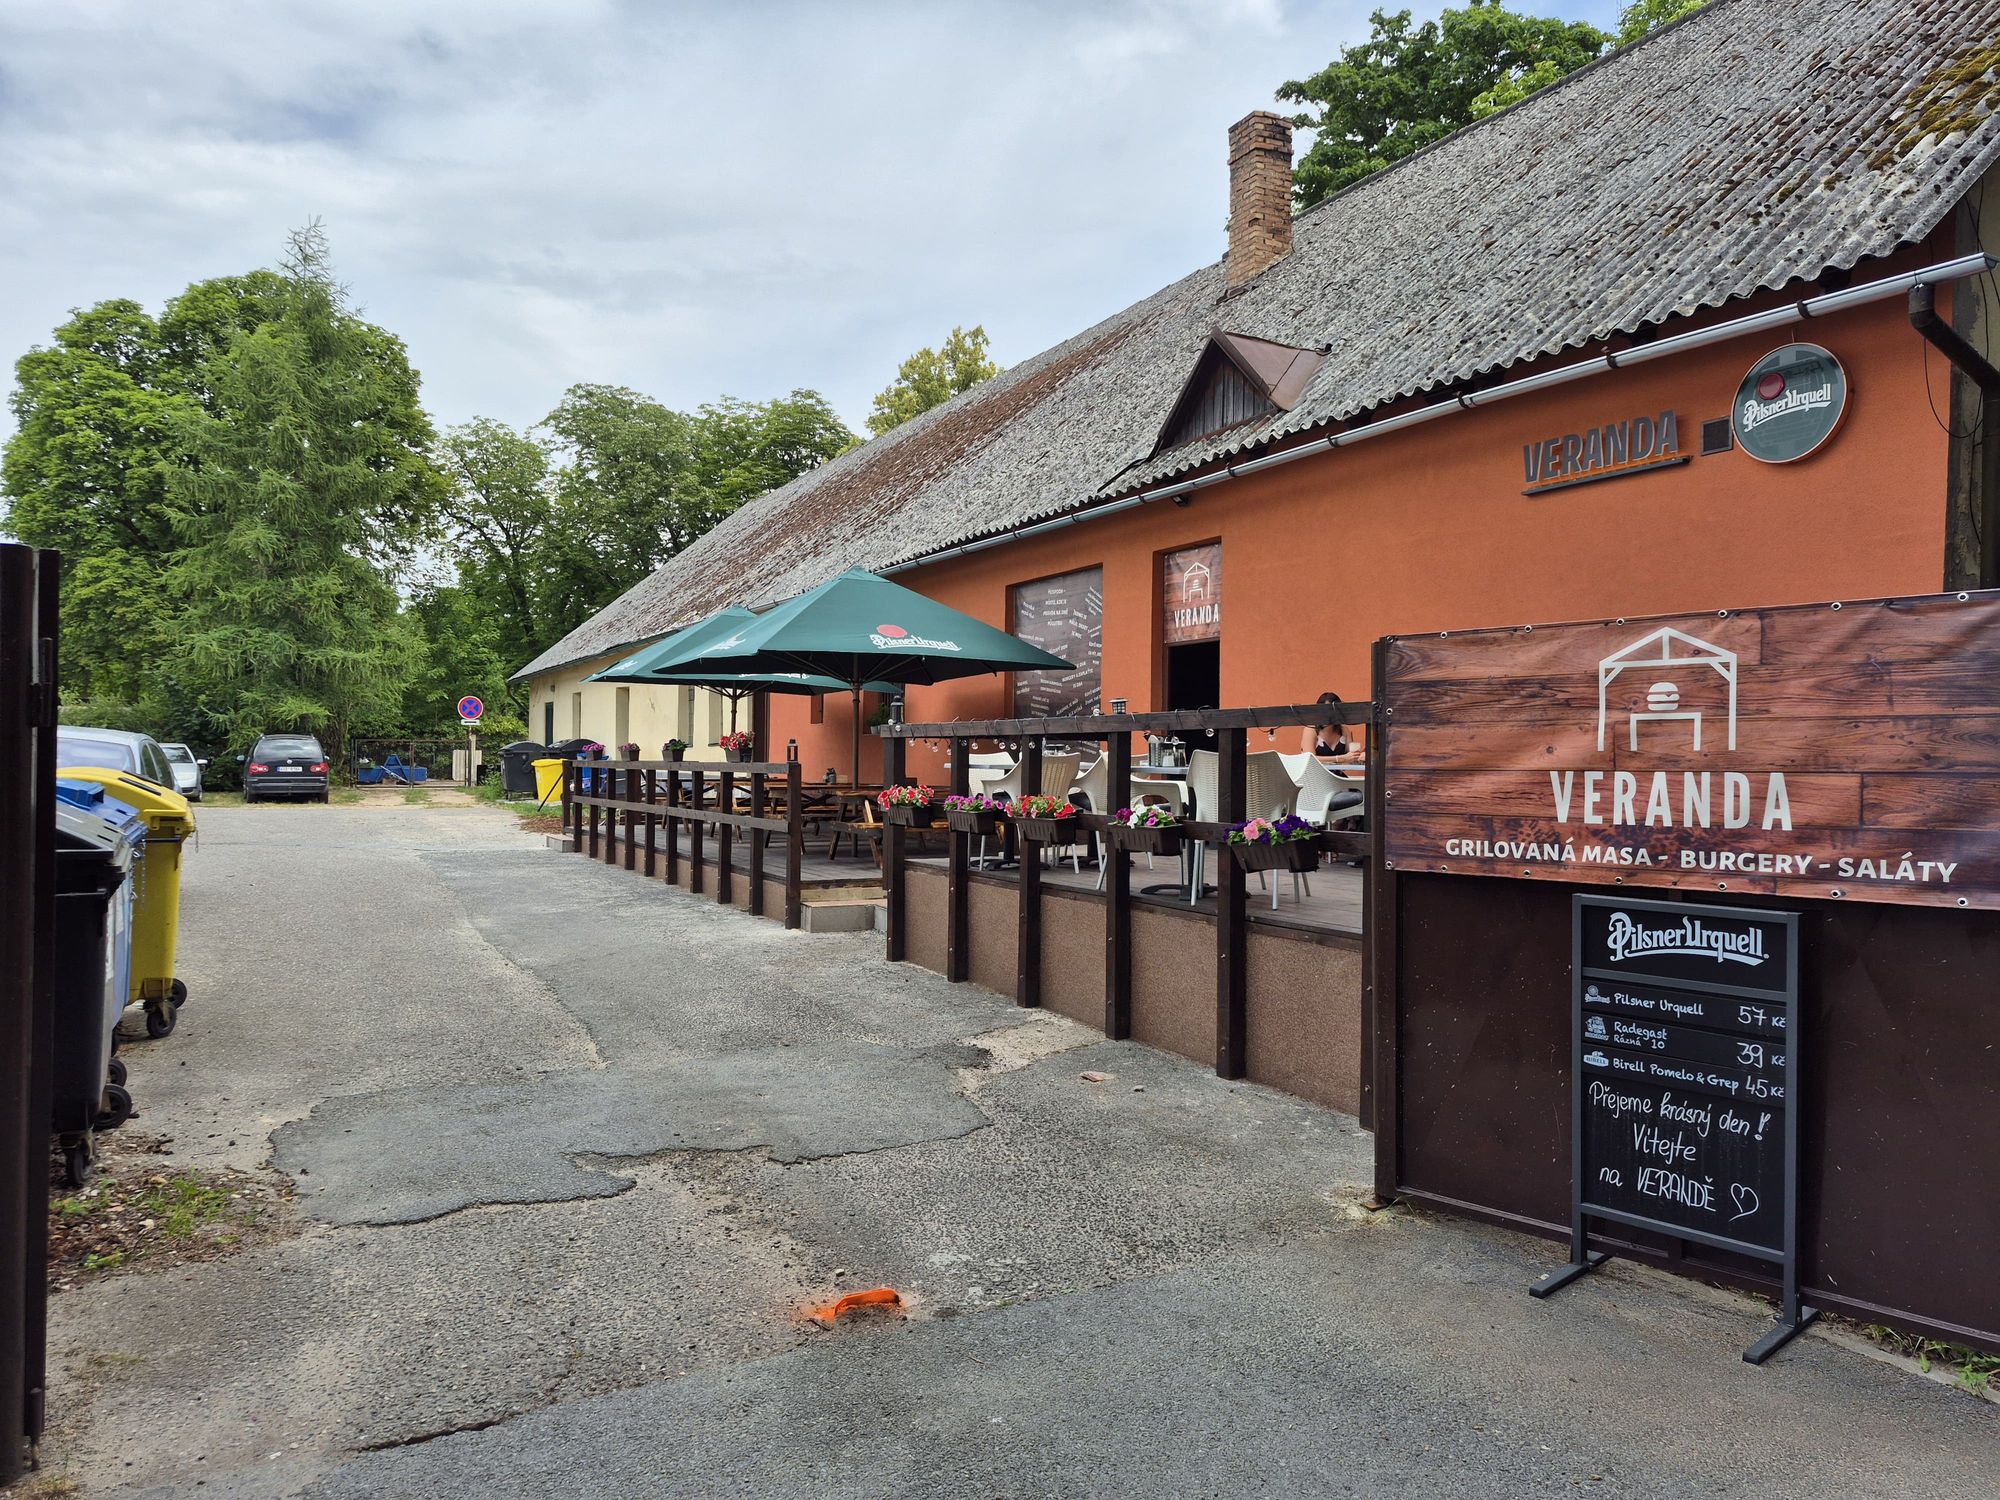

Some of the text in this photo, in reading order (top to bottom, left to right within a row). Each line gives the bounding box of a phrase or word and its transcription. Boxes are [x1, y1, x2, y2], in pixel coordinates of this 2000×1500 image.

[1523, 408, 1680, 484] VERANDA
[1174, 603, 1219, 629] VERANDA
[1549, 770, 1793, 831] VERANDA
[1445, 837, 1576, 862] GRILOVANÁ
[1582, 845, 1652, 866] MASA
[1680, 850, 1813, 875] BURGERY
[1838, 851, 1958, 883] SALÁTY
[1614, 993, 1655, 1008] Pilsner
[1660, 1000, 1704, 1018] Urquell
[1738, 1005, 1767, 1026] 57
[1771, 1016, 1786, 1028] Kč
[1614, 1033, 1641, 1046] Rázná
[1651, 1039, 1665, 1049] 10
[1614, 1021, 1667, 1041] Radegast
[1737, 1042, 1763, 1068] 39
[1771, 1055, 1785, 1067] Kč
[1613, 1057, 1785, 1098] Birell Pomelo & Grep 45 Kč
[1589, 1081, 1653, 1119] Přejeme
[1660, 1091, 1712, 1138] krásný
[1719, 1109, 1750, 1136] den
[1599, 1166, 1717, 1212] na VERANDĚ
